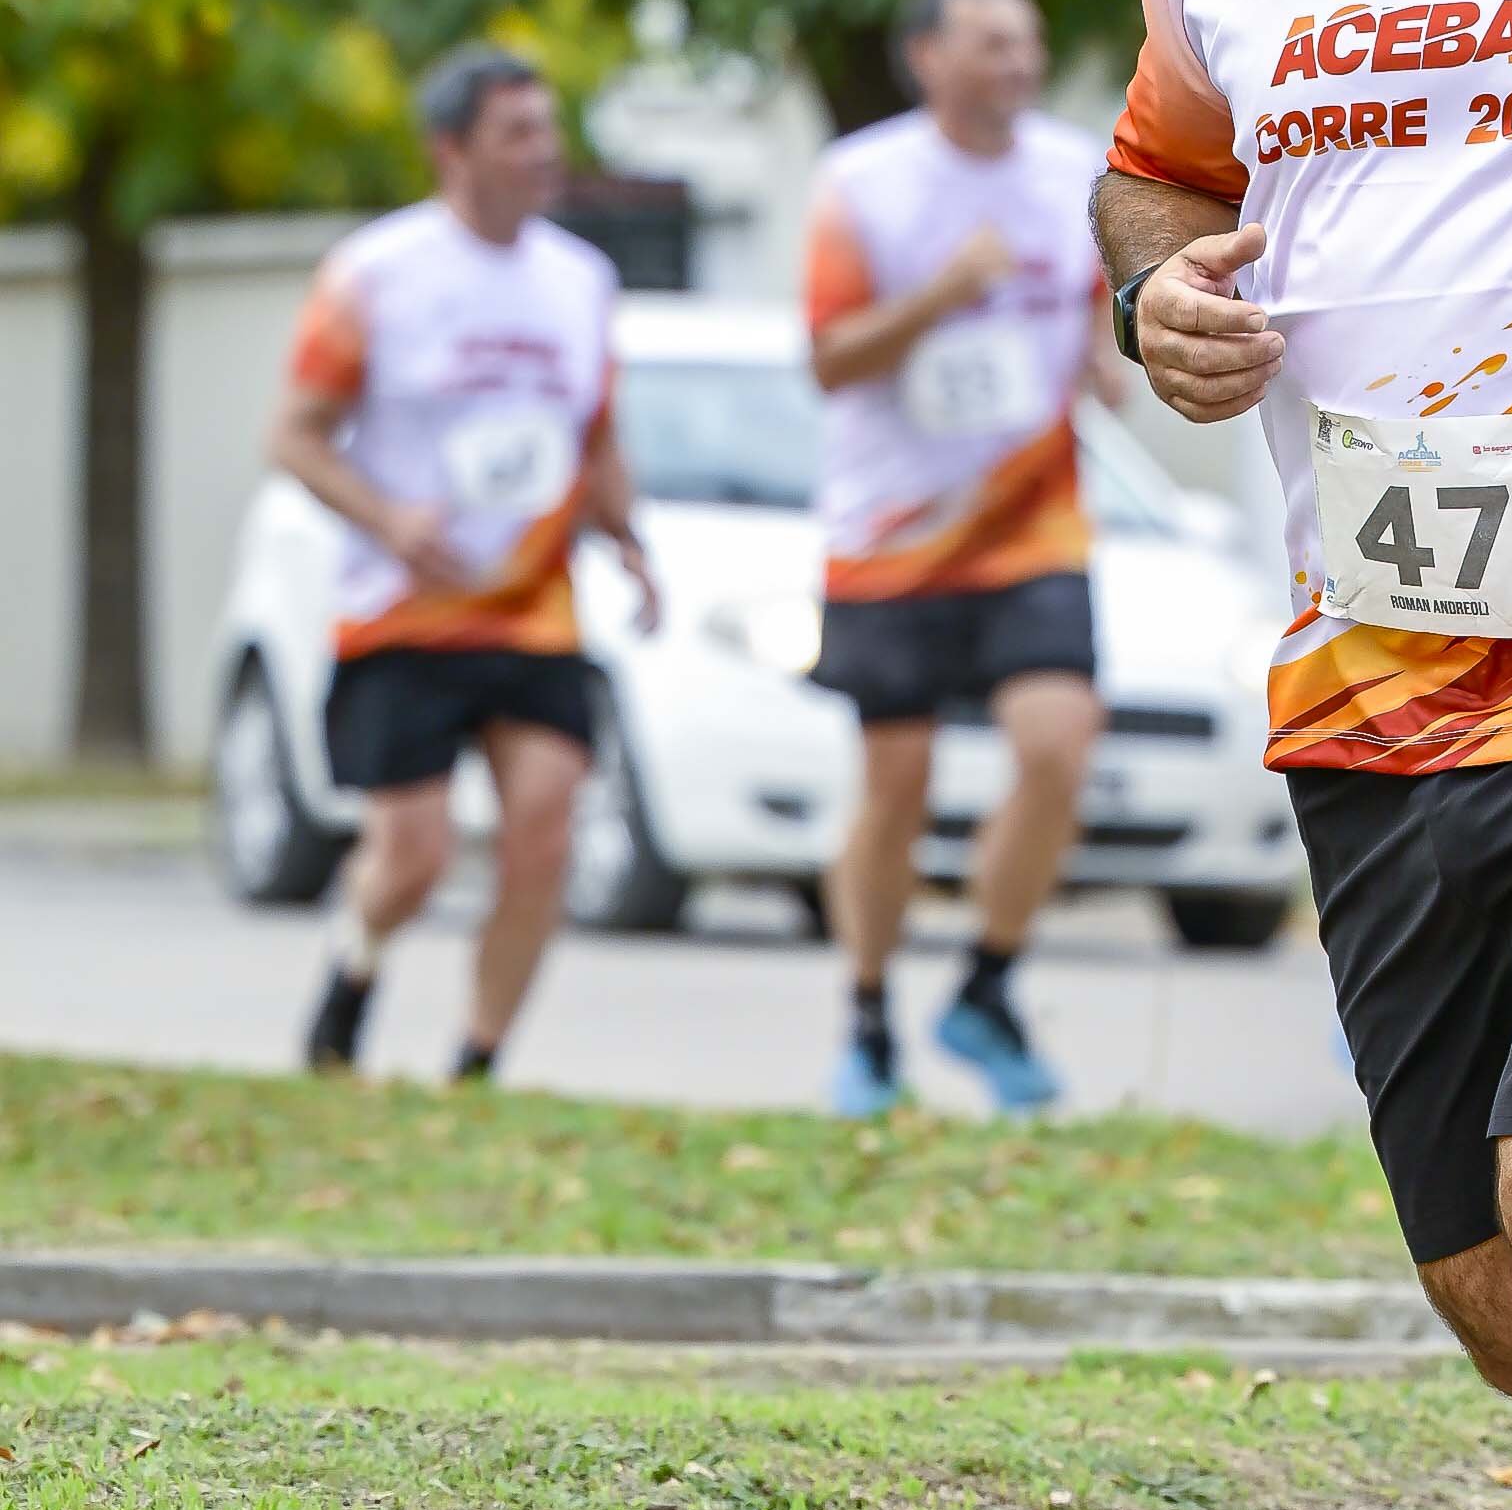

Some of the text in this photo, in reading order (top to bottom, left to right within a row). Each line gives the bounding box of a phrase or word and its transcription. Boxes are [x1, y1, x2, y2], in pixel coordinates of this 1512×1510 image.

[1256, 97, 1427, 165] CORRE
[1355, 484, 1510, 589] 47
[1390, 594, 1490, 616] ROMAN ANDREOLI
